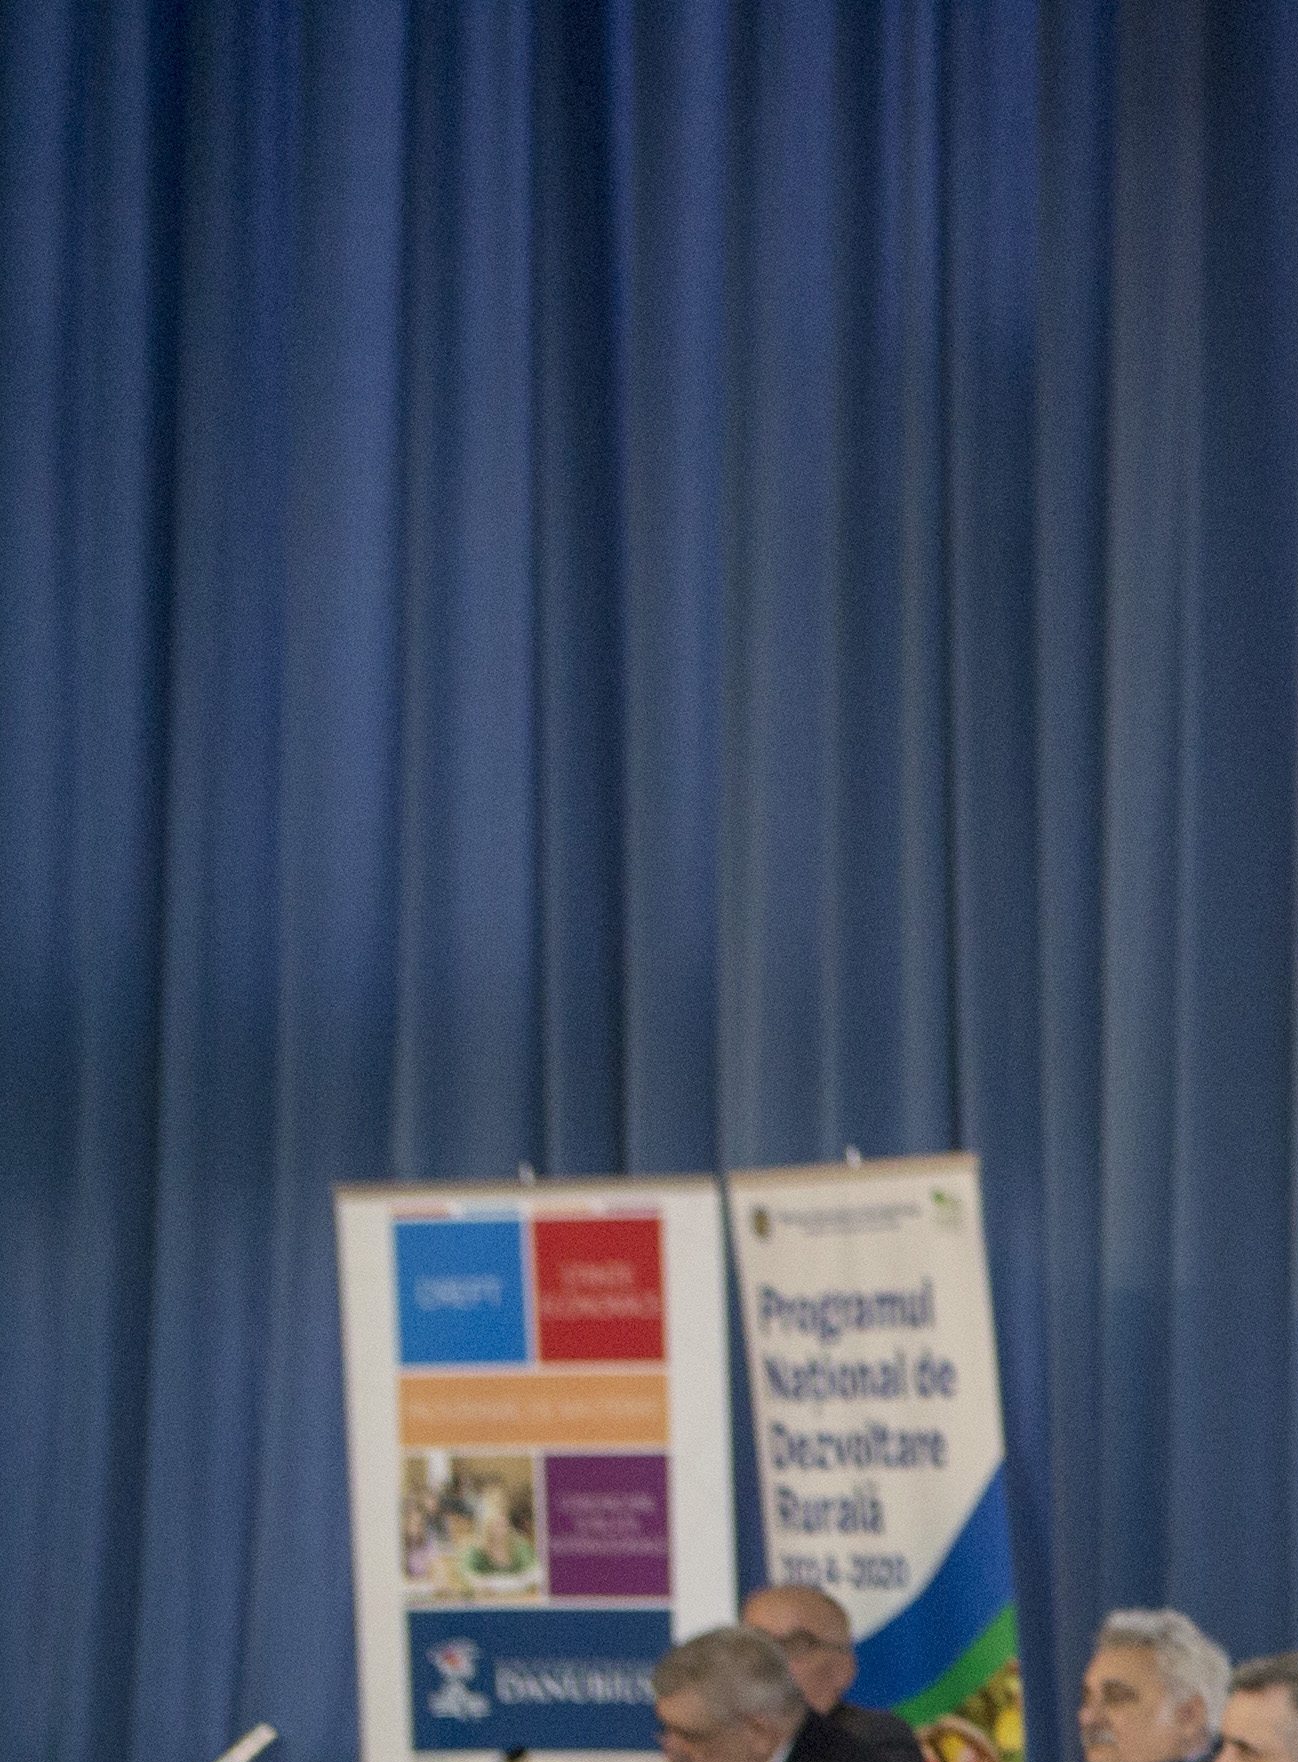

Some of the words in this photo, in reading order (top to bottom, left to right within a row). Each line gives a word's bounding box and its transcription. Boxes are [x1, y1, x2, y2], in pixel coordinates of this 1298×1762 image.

[759, 1279, 935, 1342] Programul
[913, 1352, 957, 1400] de
[771, 1419, 948, 1471] Dezvoltare
